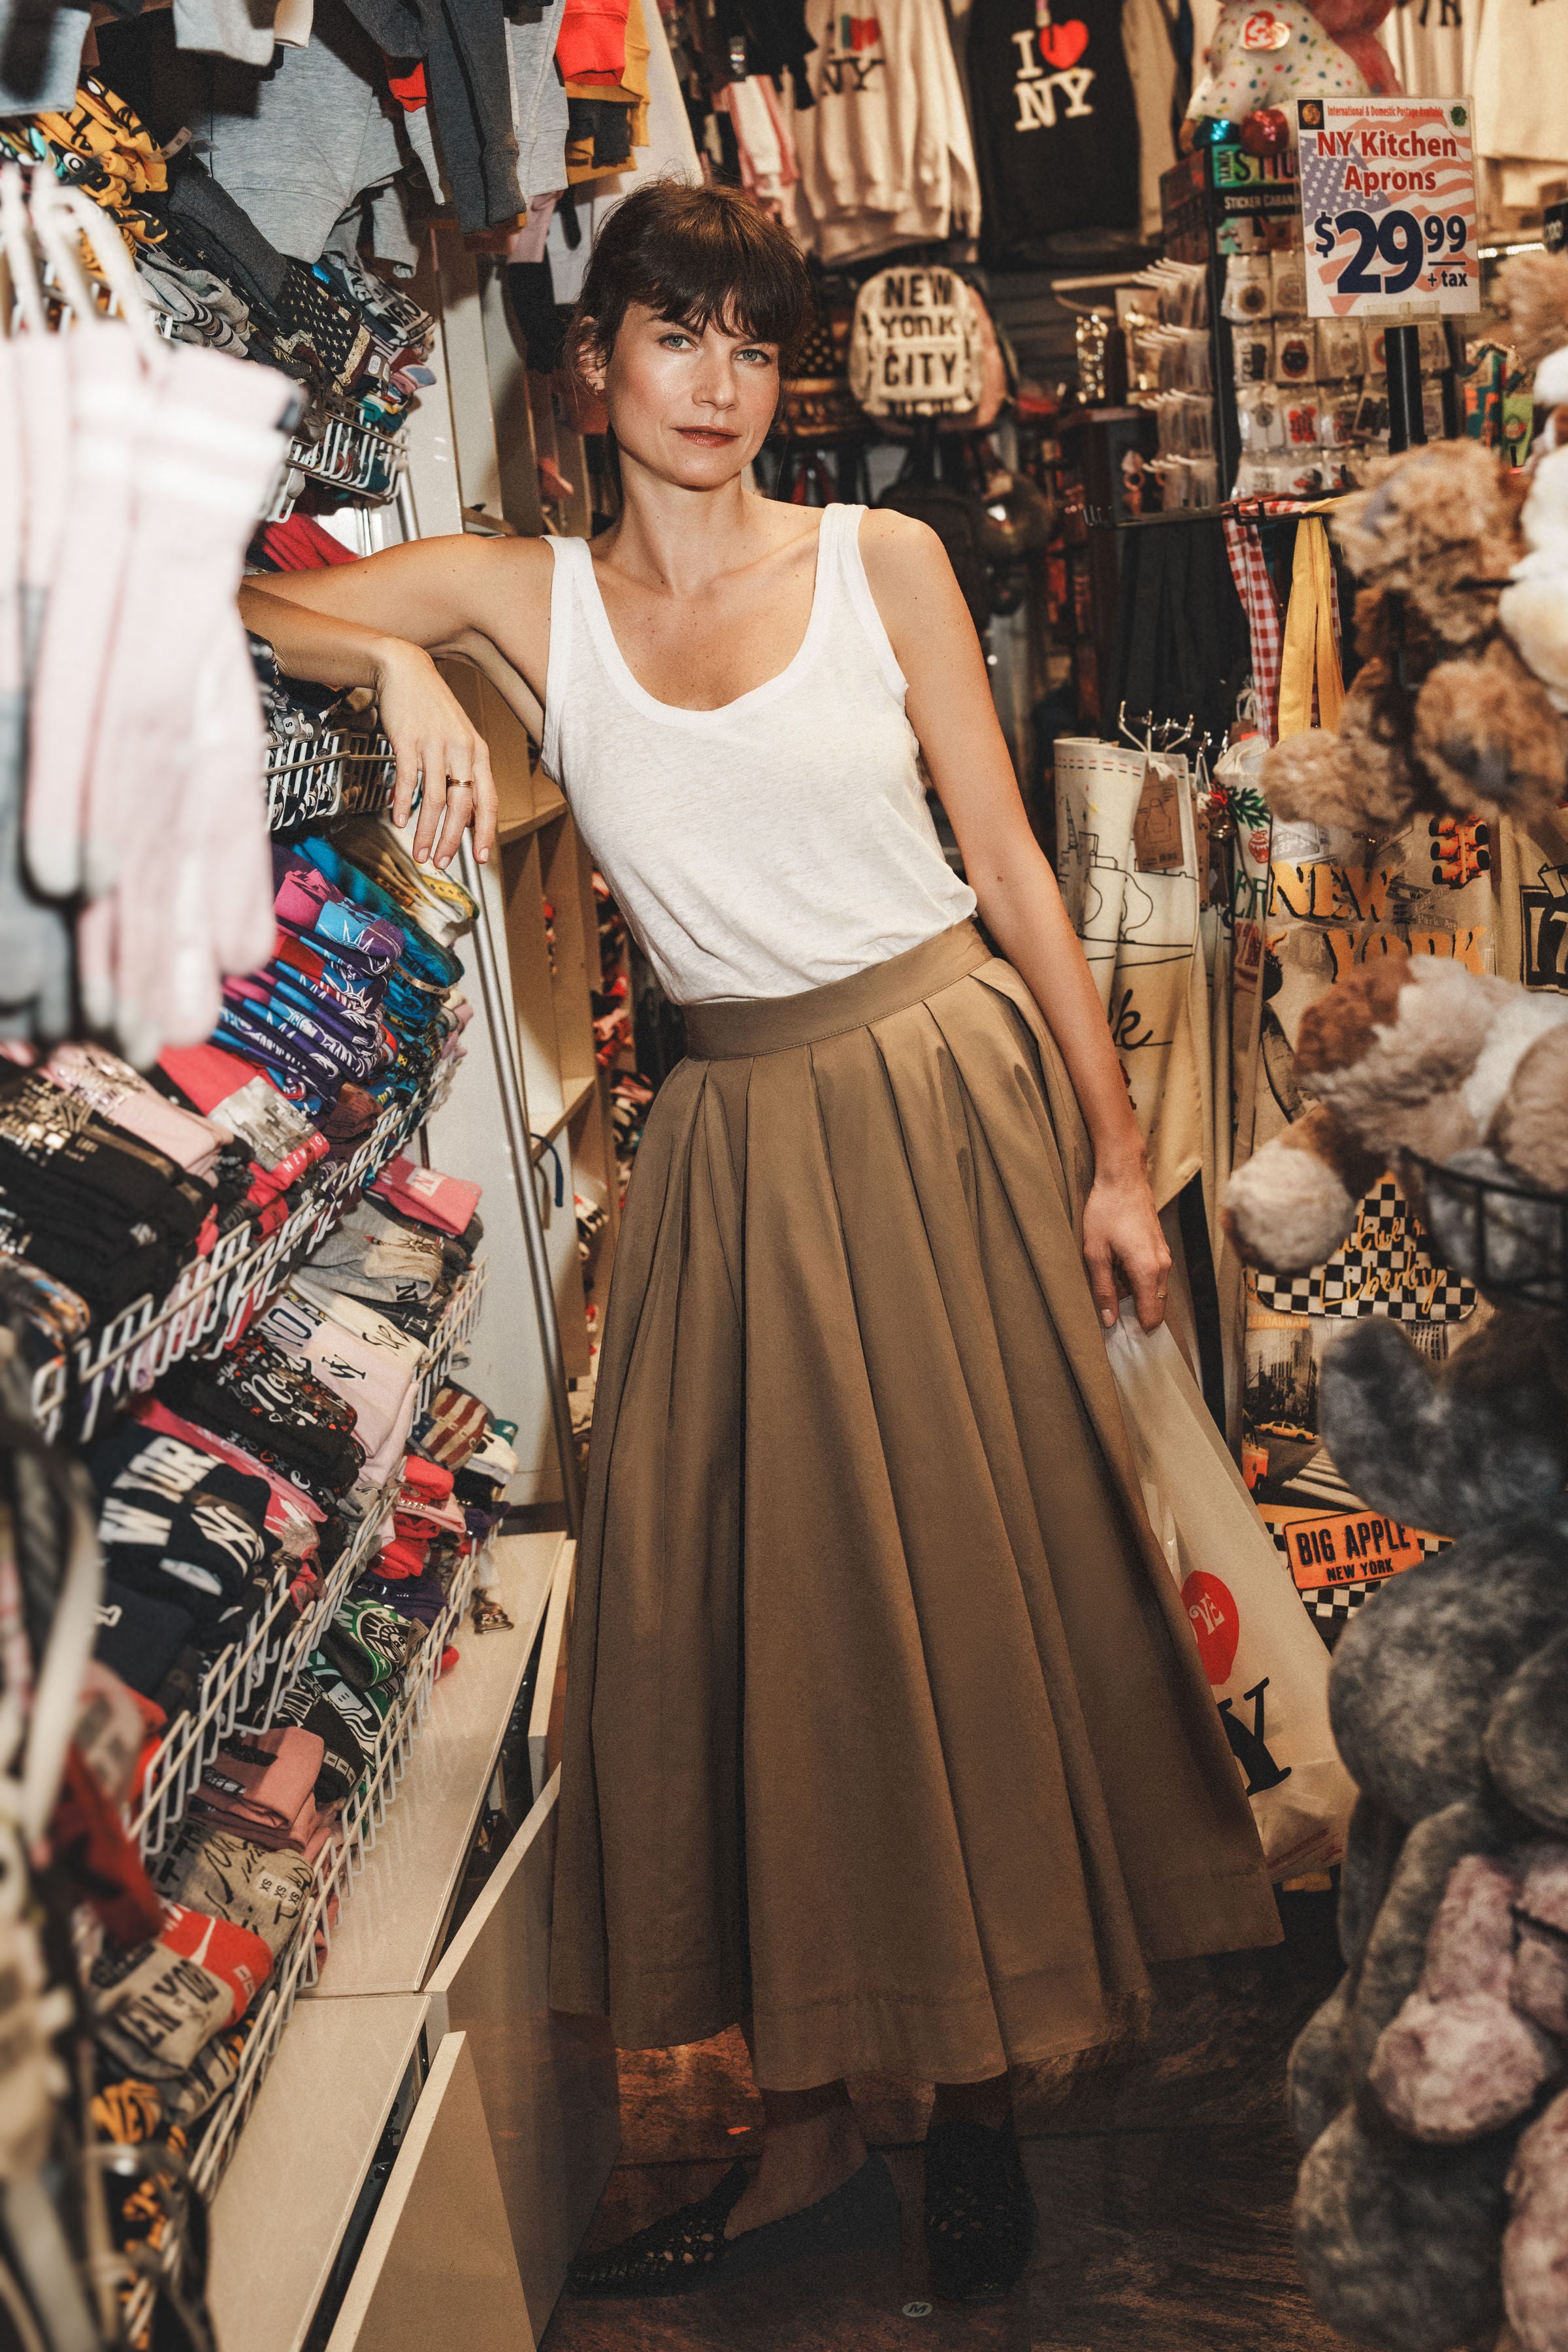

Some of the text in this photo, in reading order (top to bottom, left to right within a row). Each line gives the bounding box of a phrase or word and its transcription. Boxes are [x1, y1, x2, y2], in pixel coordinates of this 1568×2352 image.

[1014, 67, 1096, 131] NY
[1328, 106, 1364, 117] International
[1372, 106, 1396, 117] Domestic
[1317, 131, 1457, 157] NY Kitchen
[1345, 165, 1437, 197] Aprons
[885, 274, 952, 307] NEW
[1441, 269, 1468, 287] tax
[880, 315, 956, 338] YORK
[885, 351, 956, 386] CITY
[1267, 862, 1395, 922] NEW
[1319, 1245, 1447, 1315] Liberty
[112, 1436, 222, 1503] YOR
[1296, 1518, 1411, 1567] BIG APPLE
[1326, 1558, 1394, 1582] NEW YORK
[1189, 1592, 1225, 1635] VE
